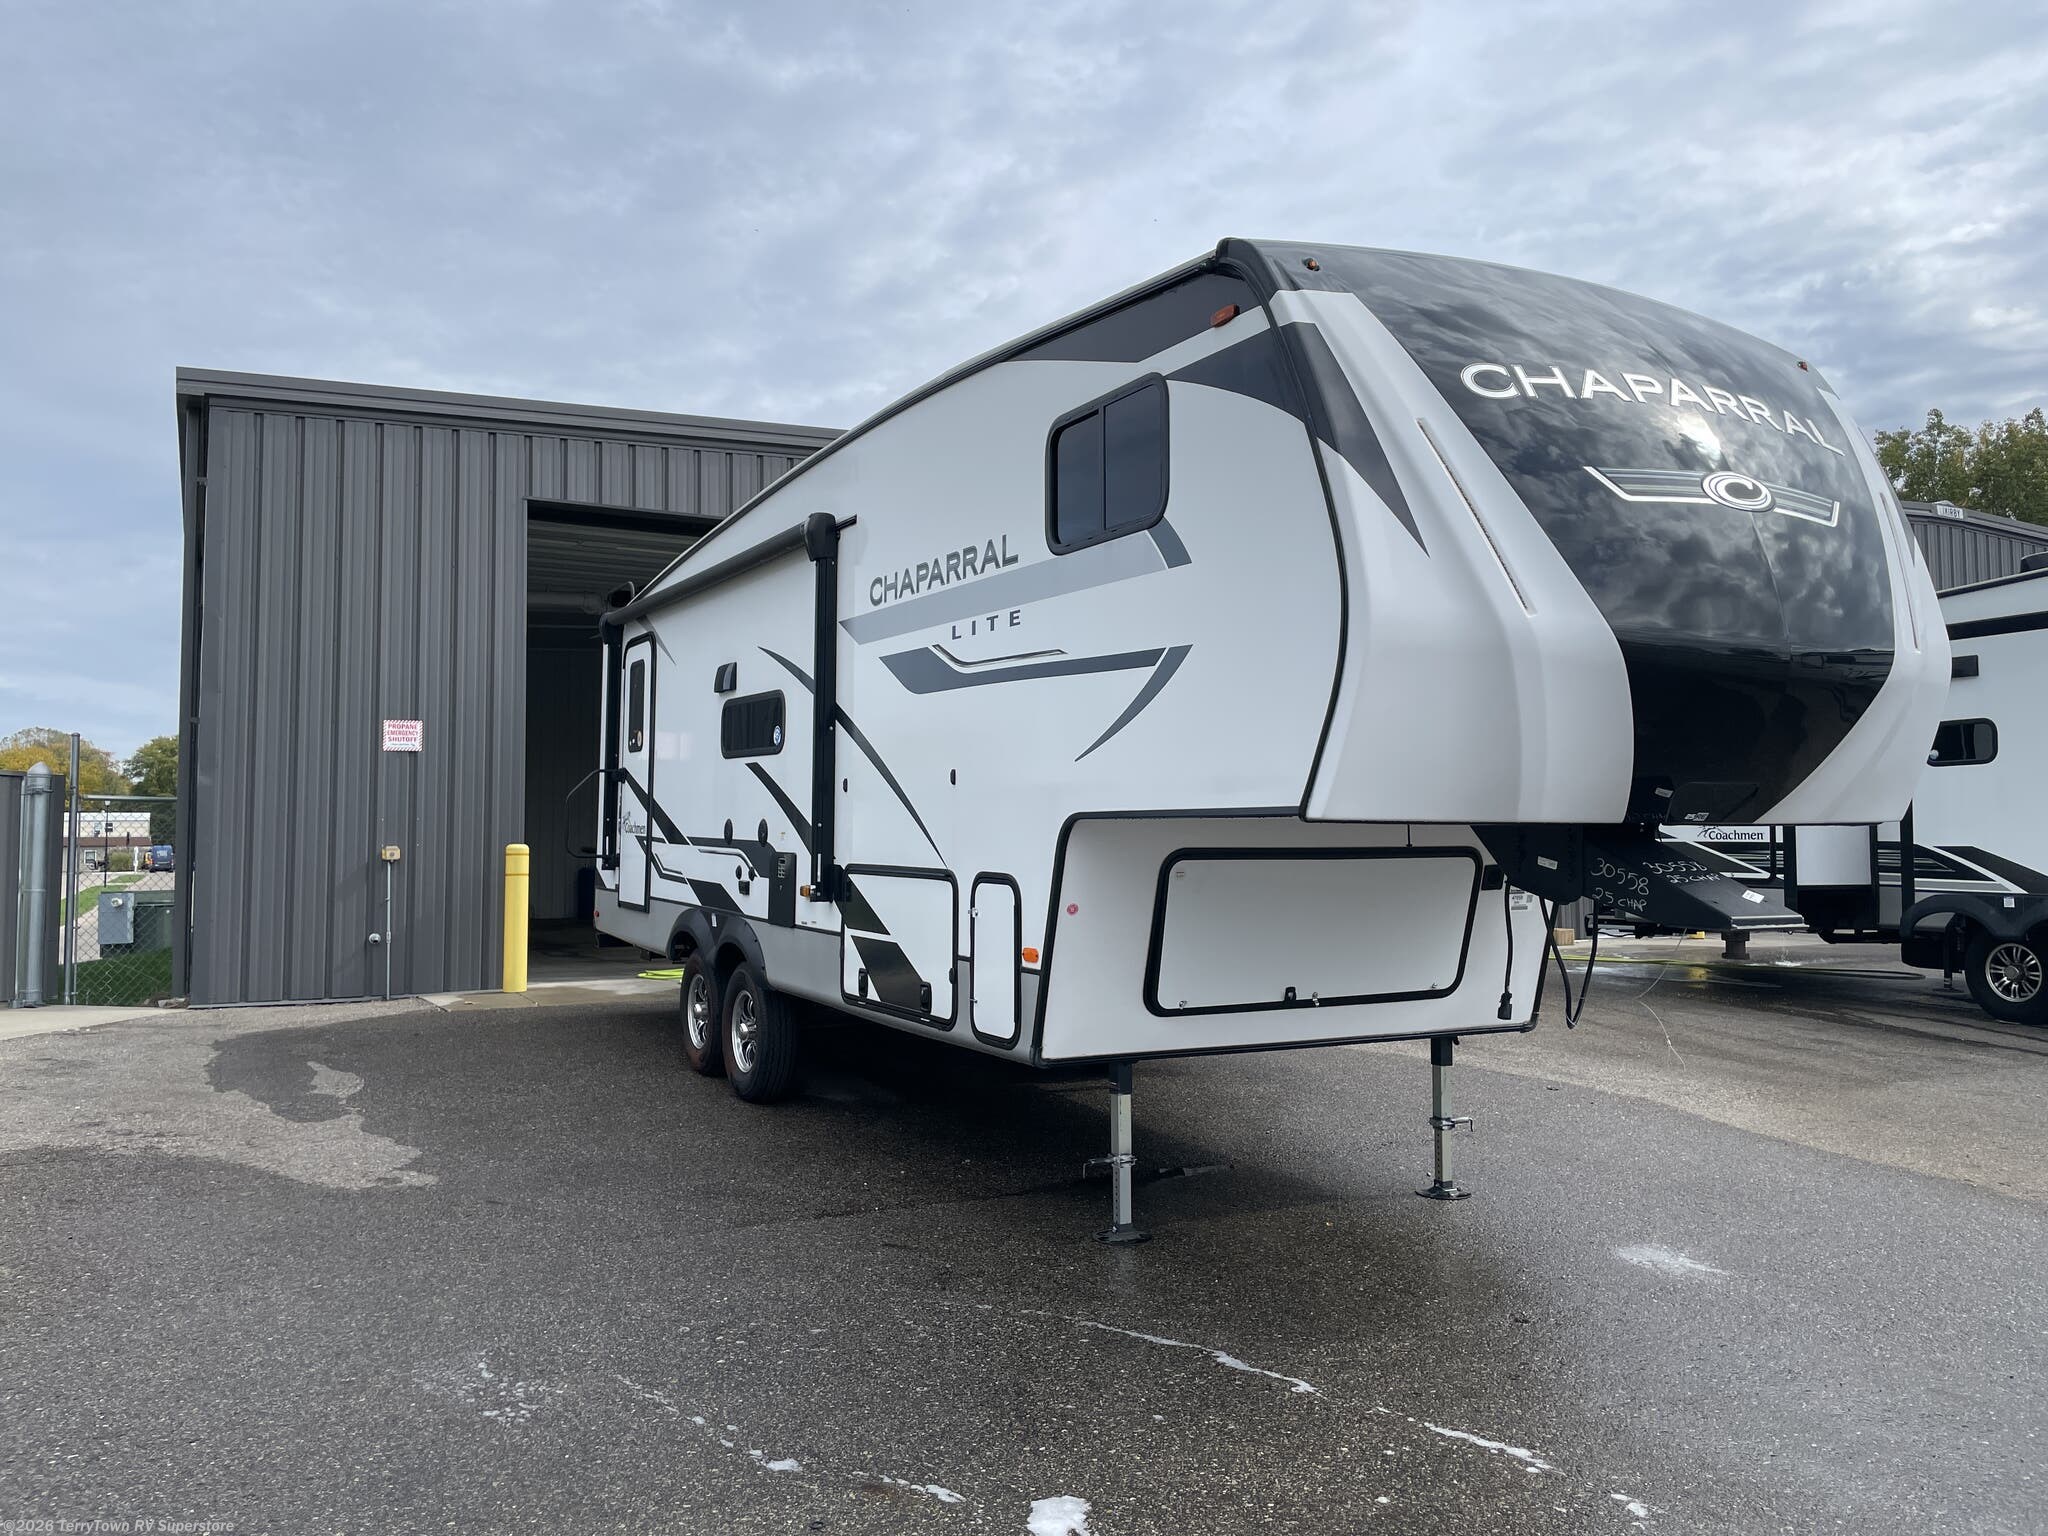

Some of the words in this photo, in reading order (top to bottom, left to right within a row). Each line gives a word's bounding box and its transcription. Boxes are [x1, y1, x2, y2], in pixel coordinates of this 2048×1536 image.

[1461, 361, 1846, 457] CHAPARRAL
[869, 534, 1019, 607] CHAPARRAL
[951, 609, 1021, 640] LITE
[1708, 829, 1764, 841] Coachmen
[1591, 858, 1649, 895] 30558
[1592, 887, 1614, 907] 25
[1617, 897, 1648, 912] CHAP
